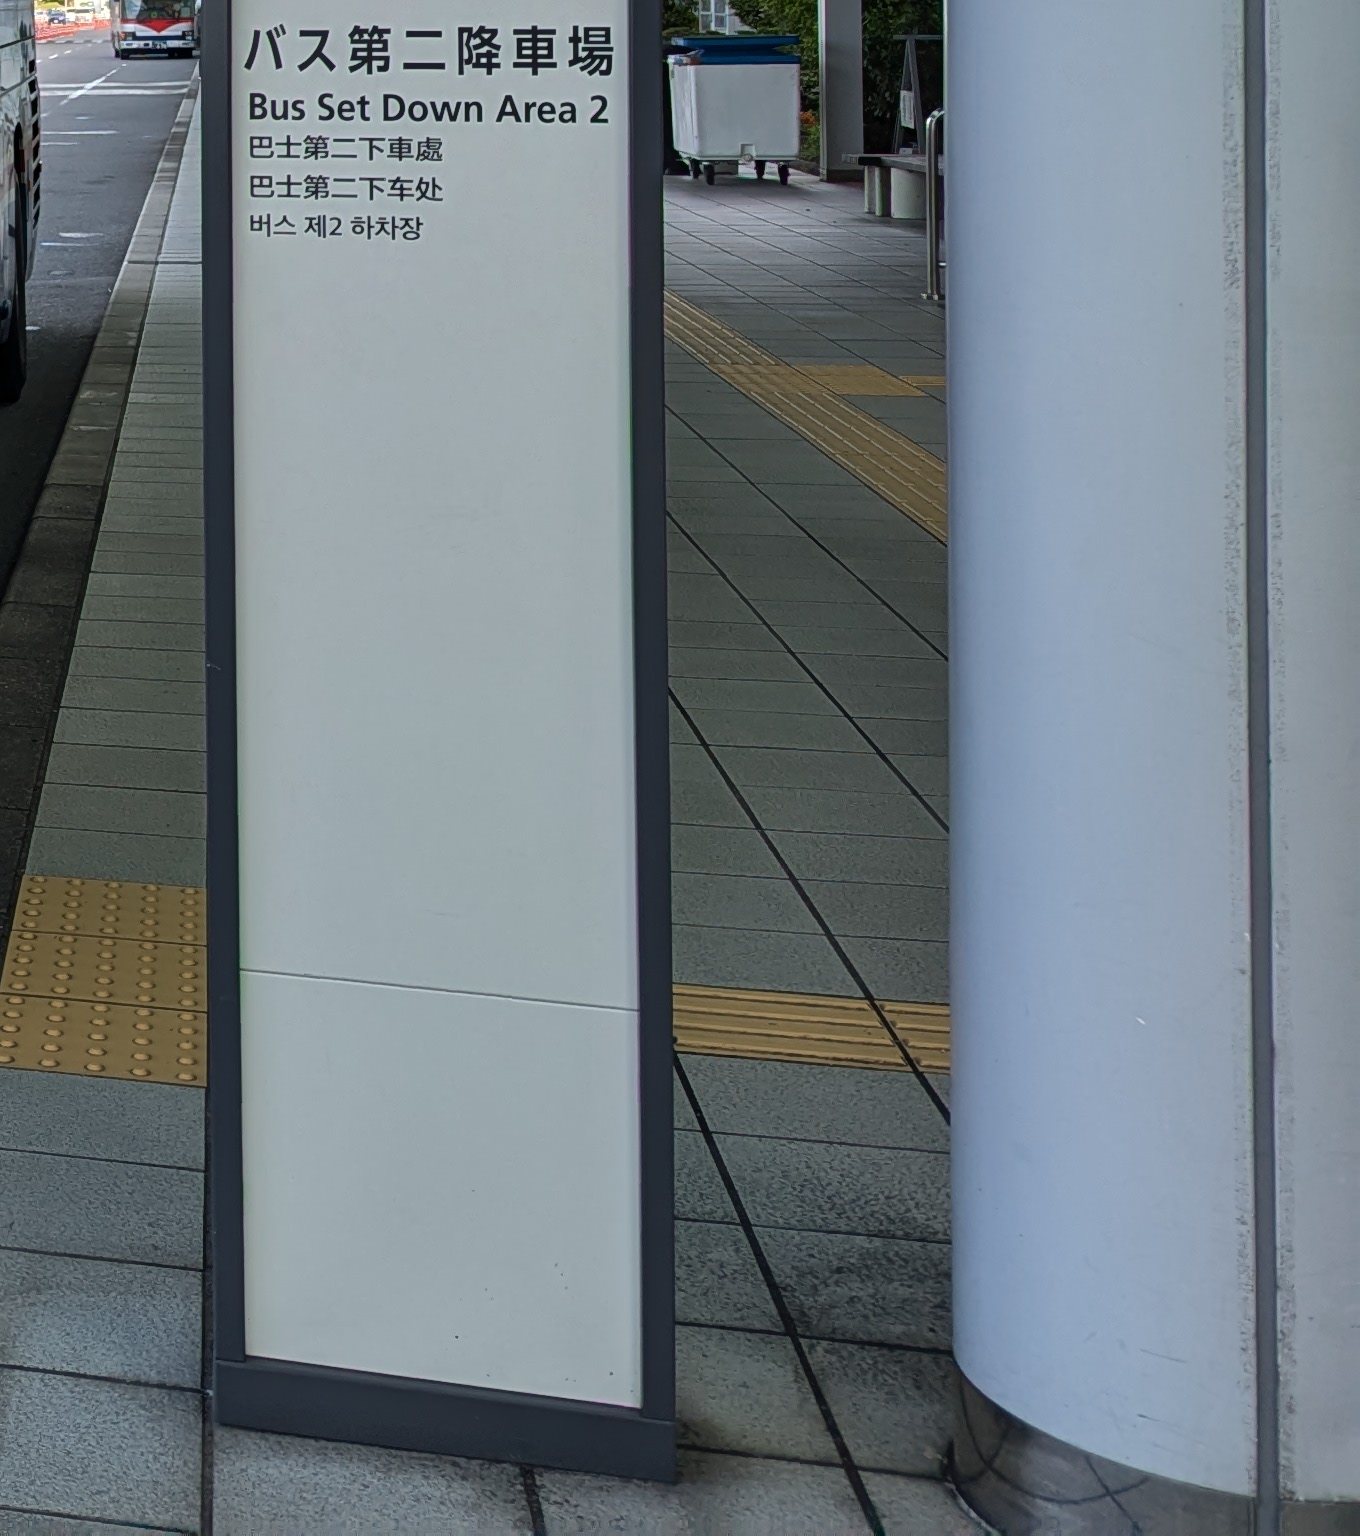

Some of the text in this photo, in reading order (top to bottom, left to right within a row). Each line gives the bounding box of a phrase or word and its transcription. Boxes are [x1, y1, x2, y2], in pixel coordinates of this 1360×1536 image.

[243, 23, 615, 78] バス第二降車場
[248, 93, 610, 124] Bus Set Down Area 2
[248, 135, 443, 163] 巴士第二下車處
[249, 175, 444, 203] 巴士第二下车处
[249, 214, 425, 242] 버스 제2 하차장
